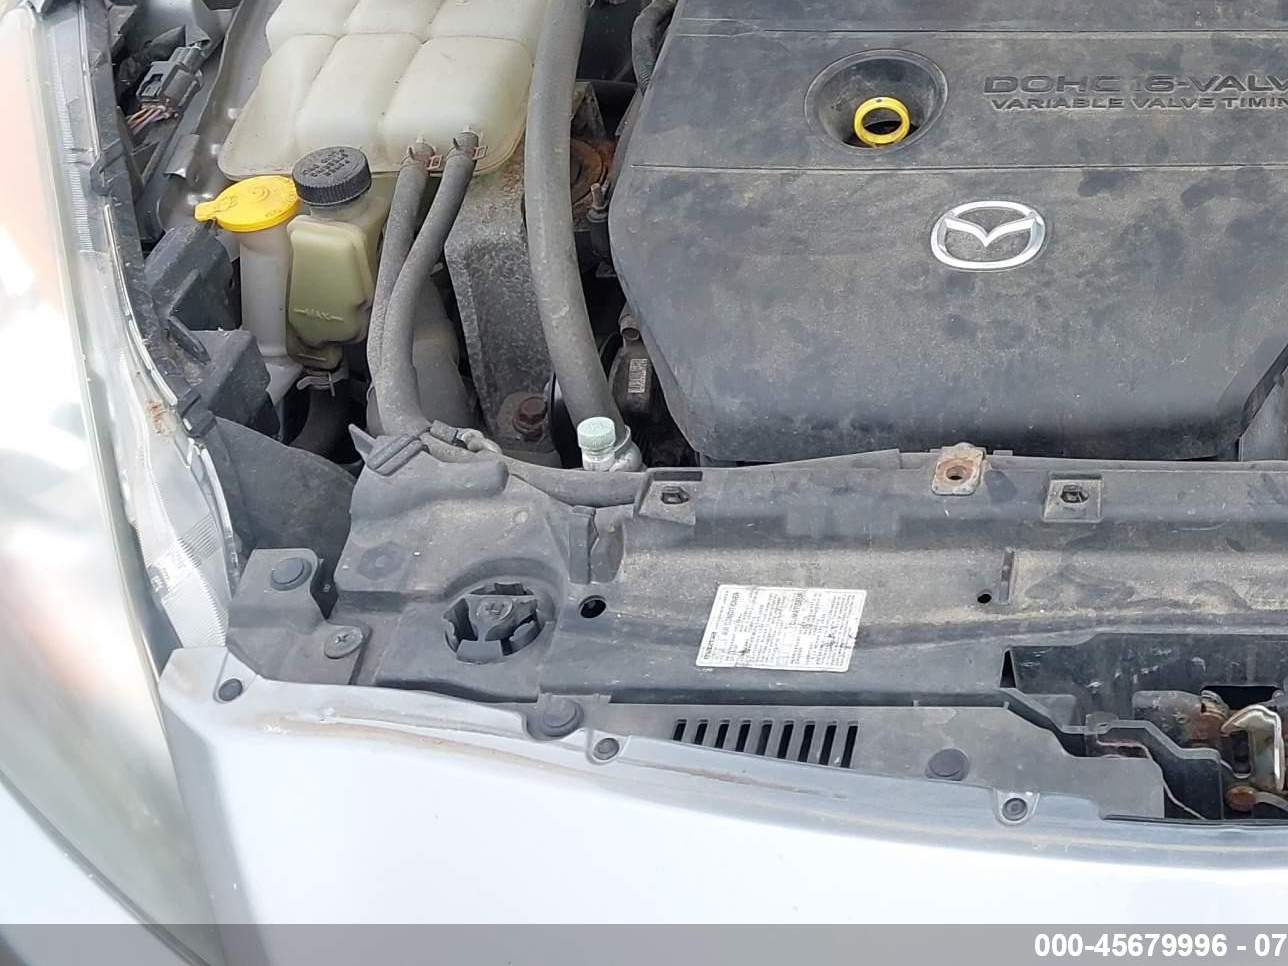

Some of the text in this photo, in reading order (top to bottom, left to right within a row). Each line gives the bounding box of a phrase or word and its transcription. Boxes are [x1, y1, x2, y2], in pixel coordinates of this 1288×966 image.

[983, 75, 1121, 94] DOHC
[990, 97, 1125, 111] VARIABLE
[1130, 96, 1216, 110] VALVE
